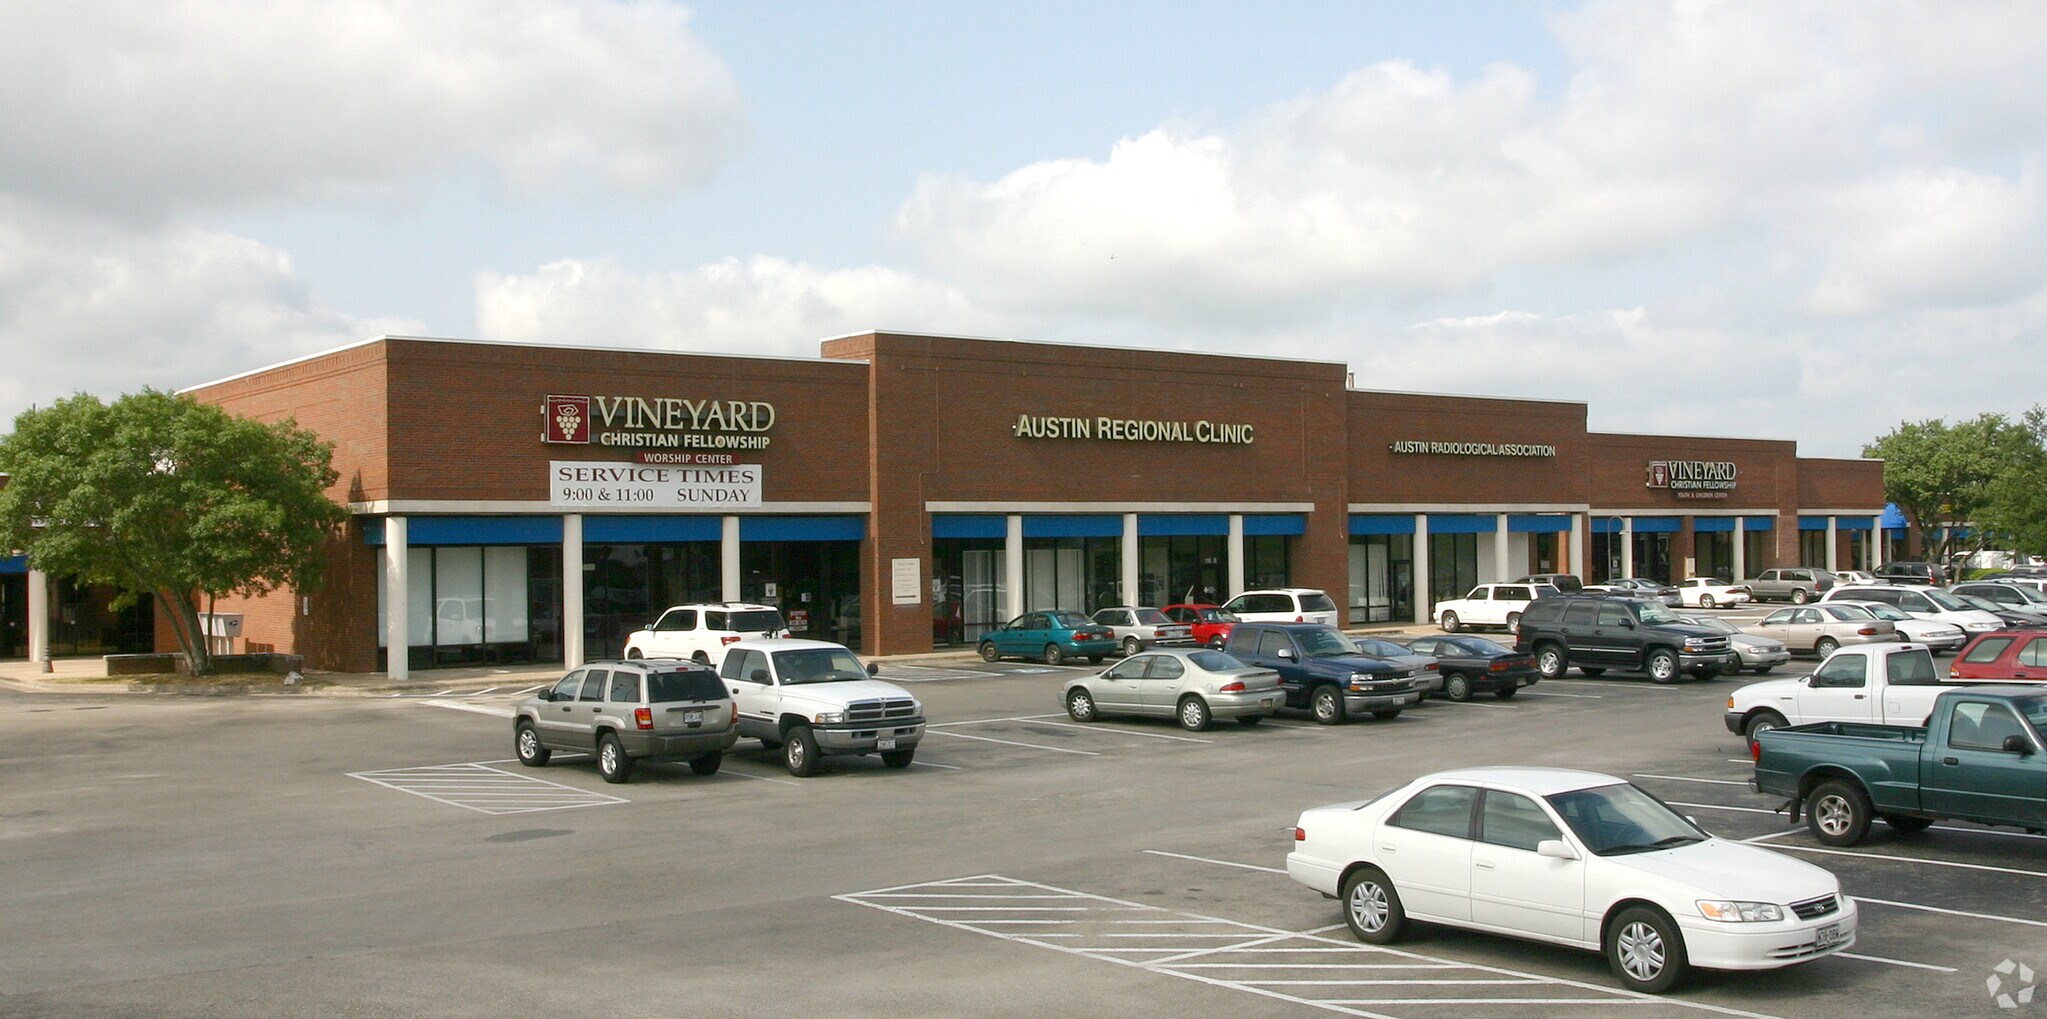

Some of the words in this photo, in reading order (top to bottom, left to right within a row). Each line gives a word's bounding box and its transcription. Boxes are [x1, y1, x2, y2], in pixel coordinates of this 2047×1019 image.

[595, 396, 776, 432] VINEYARD
[1016, 414, 1090, 439] AUSTIN
[1097, 416, 1193, 442] REGIONAL
[1195, 420, 1254, 444] CLINIC
[600, 431, 678, 448] CHRISTIAN
[683, 434, 770, 449] FELLOWSHIP
[1394, 441, 1429, 454] AUSTIN
[1431, 442, 1498, 456] RADIOLOGICAL
[1499, 444, 1556, 457] ASSOCIATION
[643, 453, 692, 464] WORSHIP
[695, 454, 733, 464] CENTER
[558, 467, 670, 483] SERVICE
[676, 469, 754, 484] TIMES
[1667, 461, 1736, 480] VINEYARD
[1671, 480, 1701, 489] CHRISTIAN
[1703, 481, 1736, 489] FELLOWSHIP
[563, 487, 593, 501] 9:00
[598, 488, 612, 501] &
[616, 488, 654, 501] 11:00
[677, 488, 750, 503] SUNDAY
